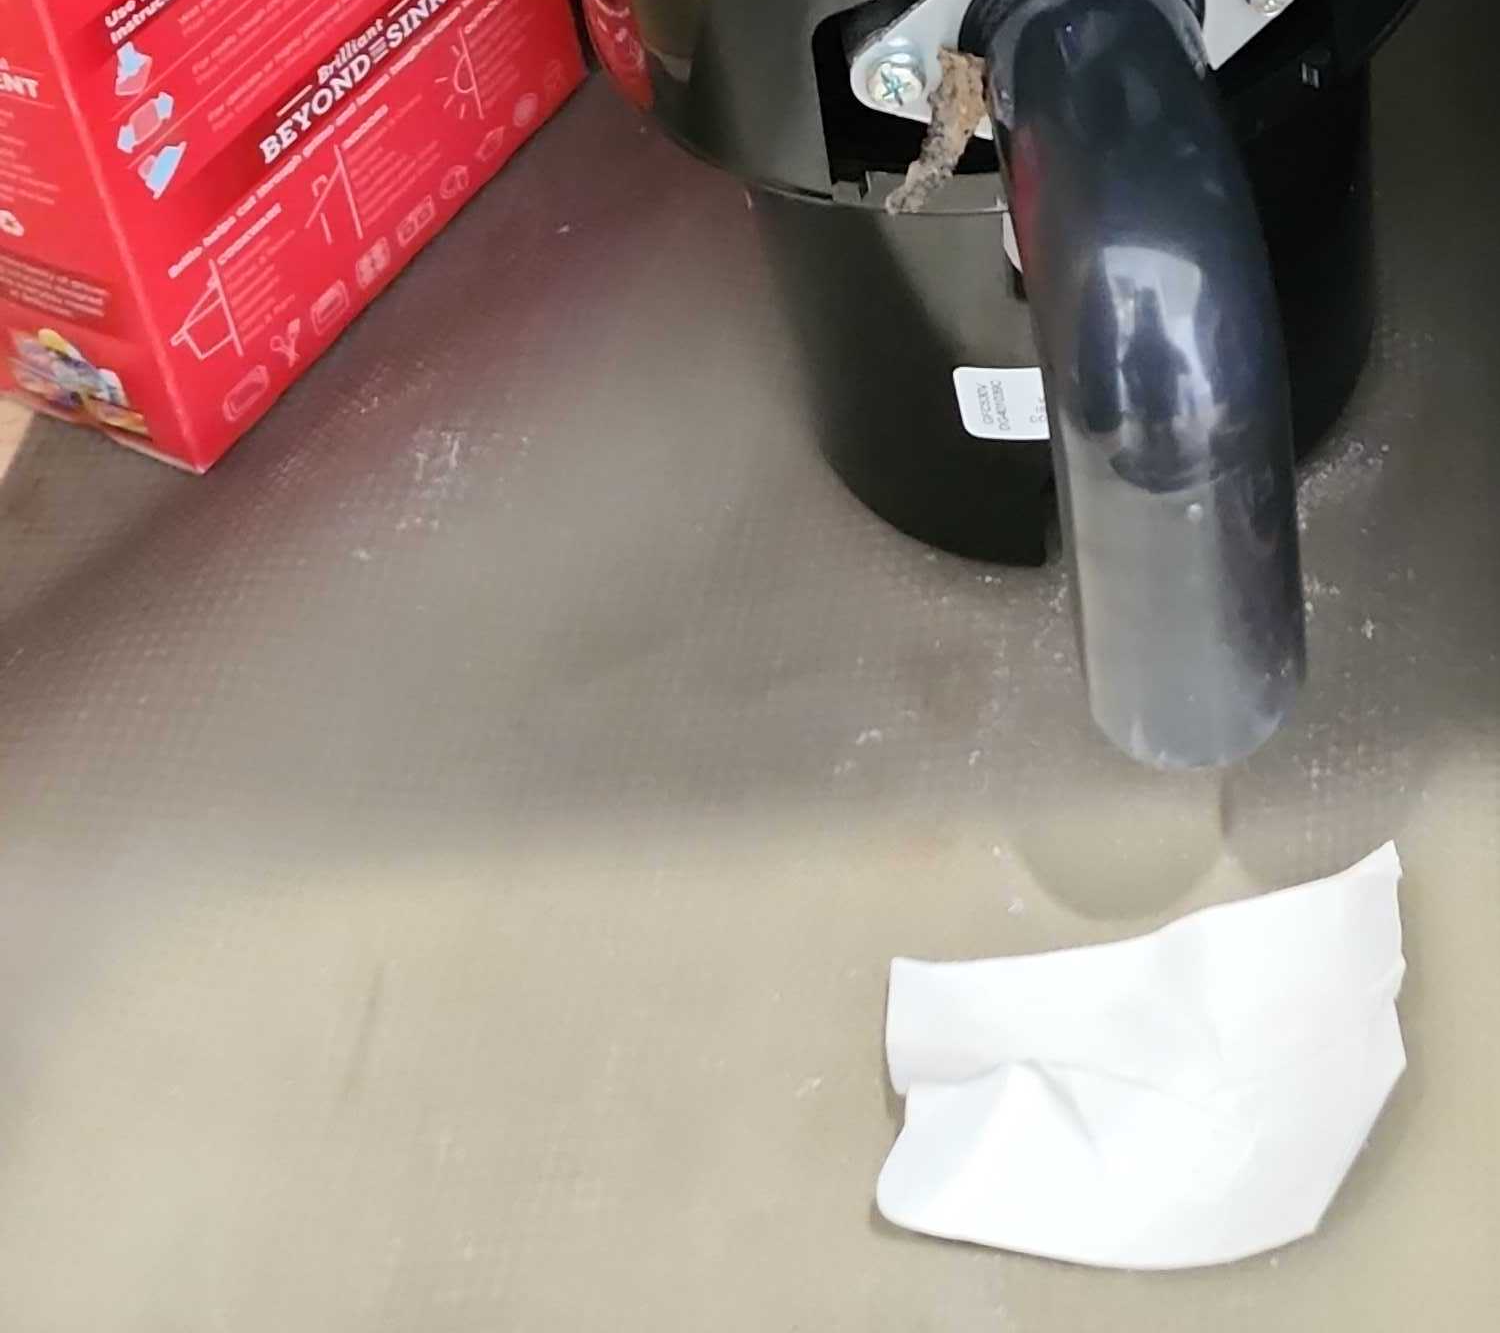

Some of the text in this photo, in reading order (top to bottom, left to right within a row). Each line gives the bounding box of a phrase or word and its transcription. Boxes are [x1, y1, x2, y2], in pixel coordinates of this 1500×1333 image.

[104, 0, 135, 27] Use
[317, 18, 383, 84] Brilliant
[259, 54, 370, 163] BEYOND
